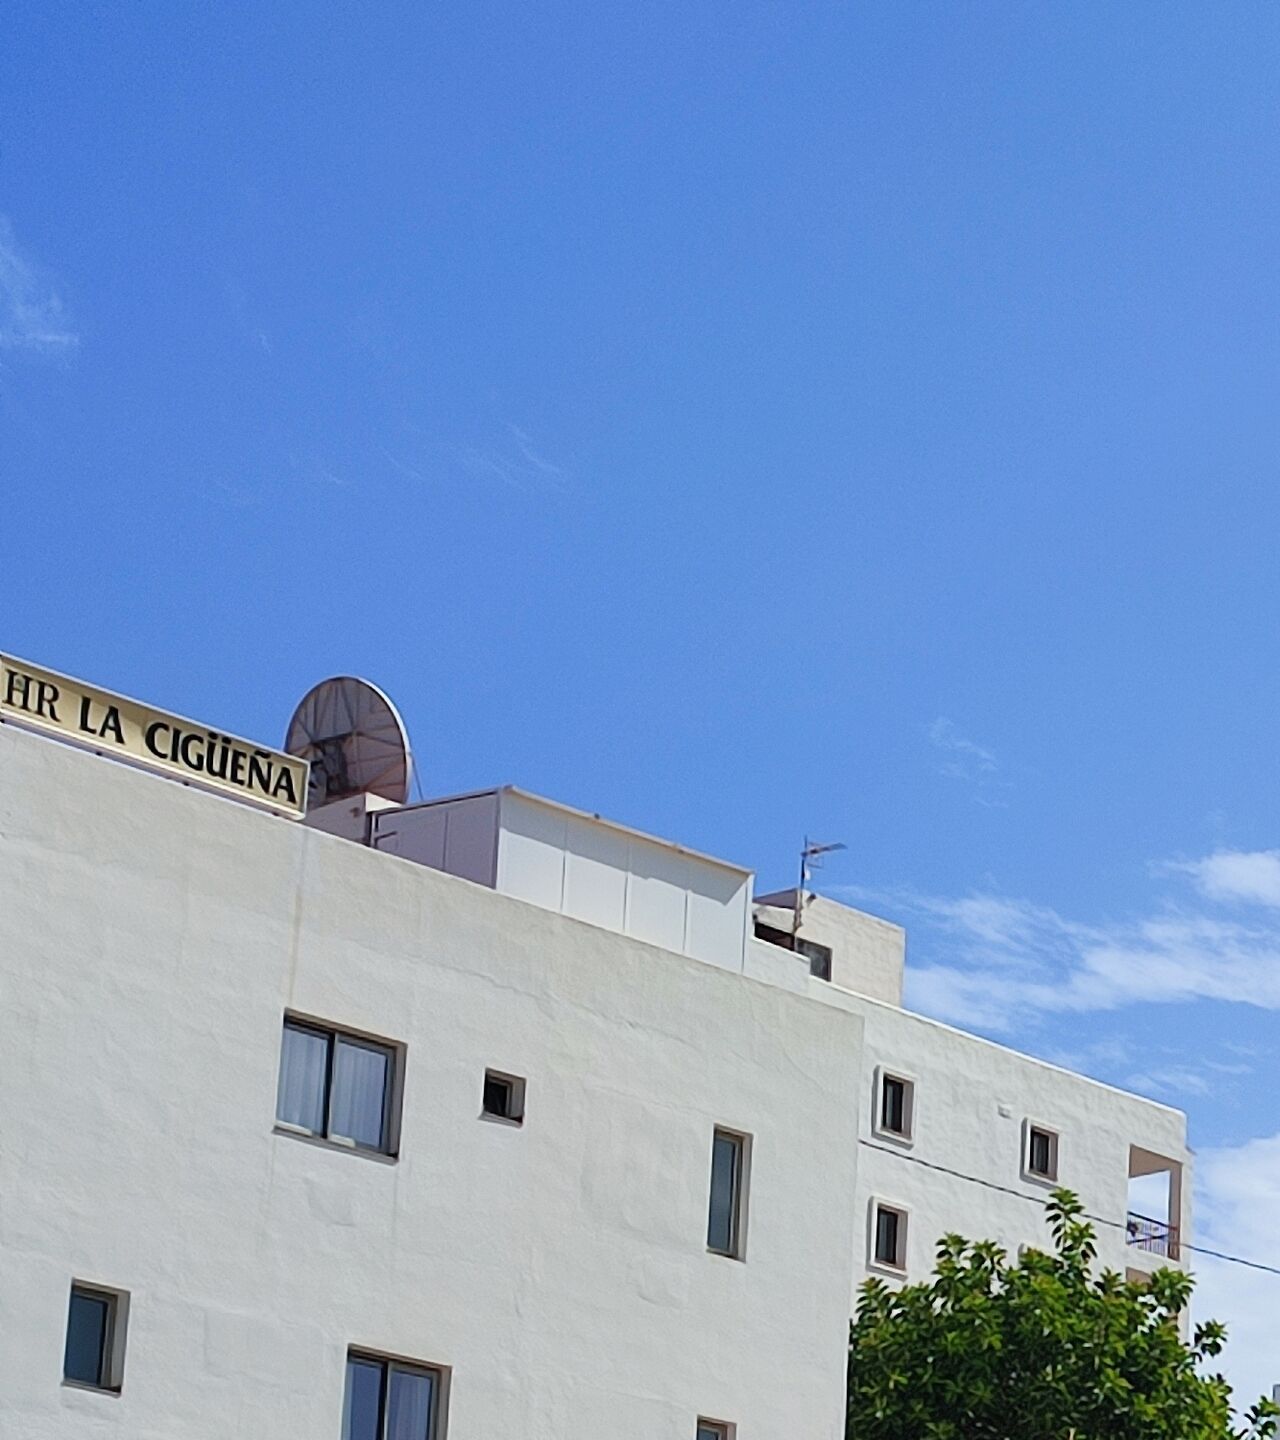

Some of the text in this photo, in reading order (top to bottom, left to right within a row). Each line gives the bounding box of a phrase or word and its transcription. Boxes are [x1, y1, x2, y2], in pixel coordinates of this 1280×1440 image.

[5, 668, 298, 804] HR LA CIGÜEÑA
